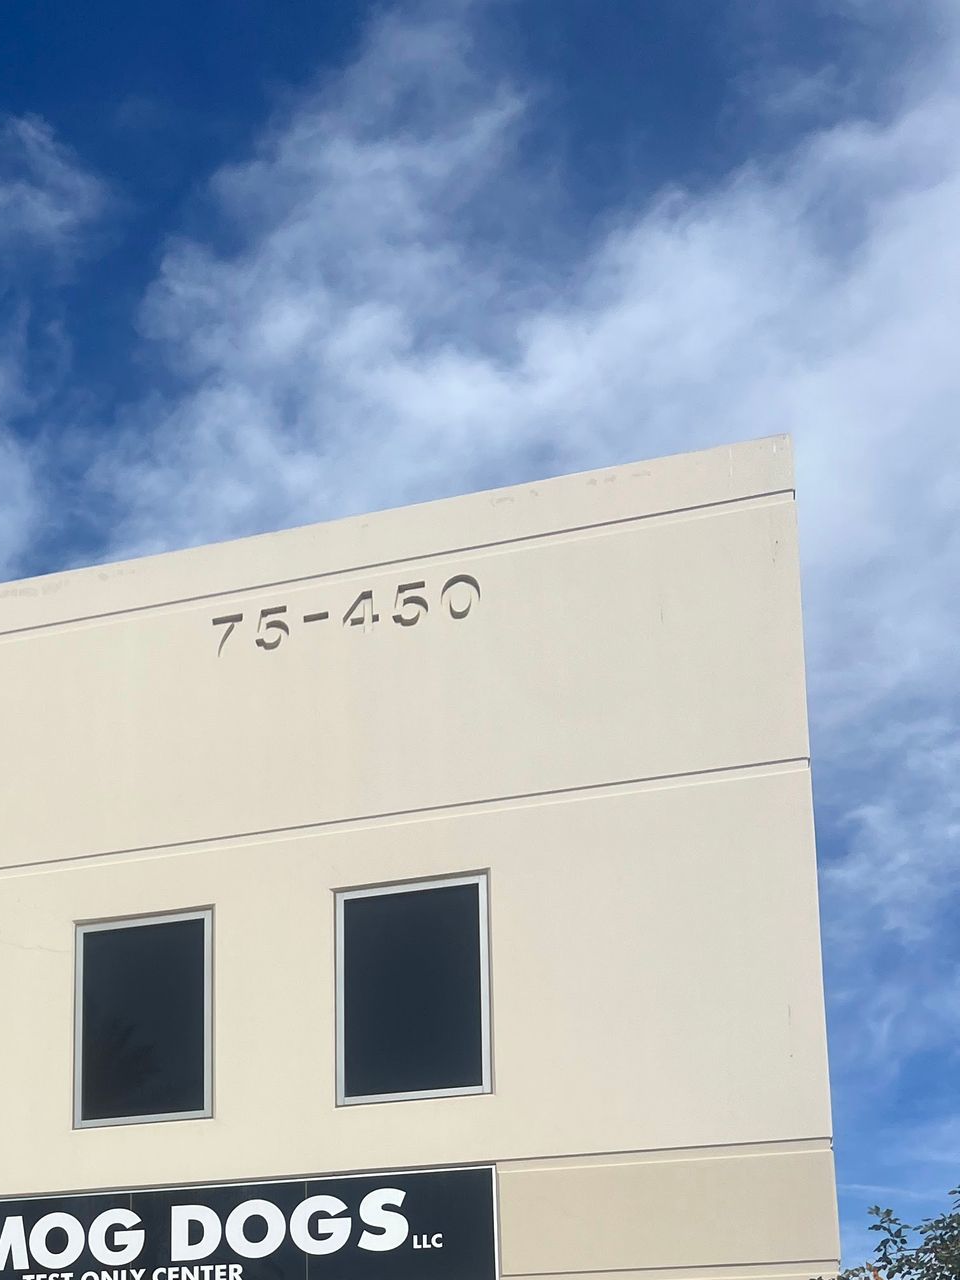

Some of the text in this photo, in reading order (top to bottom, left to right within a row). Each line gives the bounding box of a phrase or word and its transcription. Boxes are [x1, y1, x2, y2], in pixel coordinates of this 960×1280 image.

[211, 573, 482, 658] 75-450
[170, 1187, 410, 1262] DOGS
[412, 1233, 443, 1250] LLC
